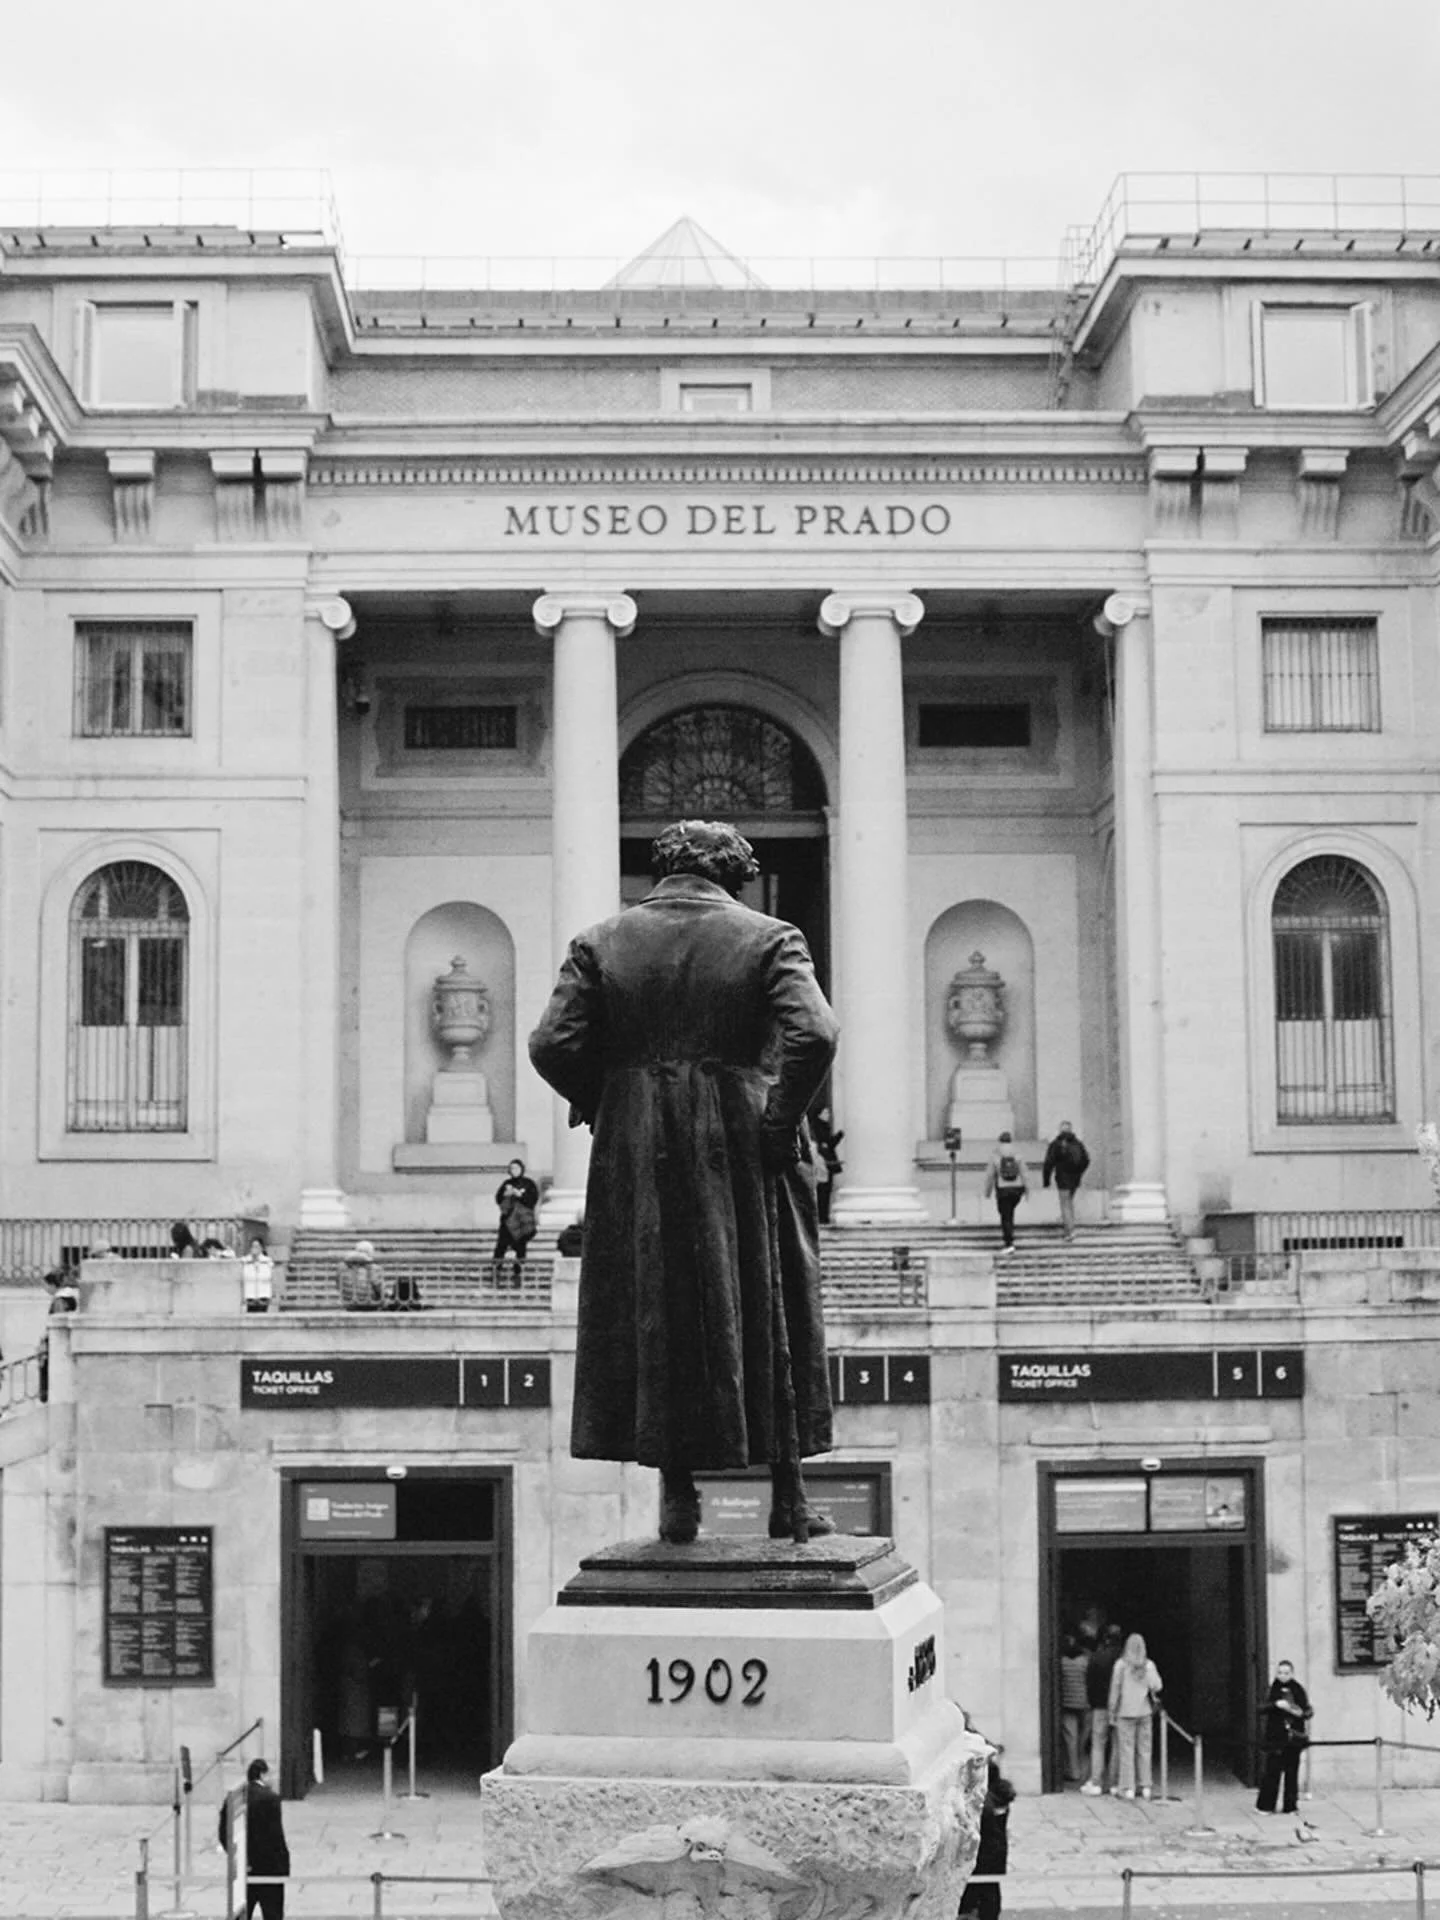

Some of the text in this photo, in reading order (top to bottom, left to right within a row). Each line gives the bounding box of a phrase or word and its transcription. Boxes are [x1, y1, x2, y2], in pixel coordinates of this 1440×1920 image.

[504, 504, 950, 536] MUSEO DEL PRADO
[253, 1370, 534, 1388] TAQUILLAS 1 2
[859, 1370, 915, 1385] 3 4
[1011, 1363, 1287, 1381] TAQUILLAS 5 6
[253, 1385, 319, 1394] TICKET OFFICE
[1011, 1379, 1077, 1388] TICKET OFFICE
[647, 1658, 767, 1706] 1902
